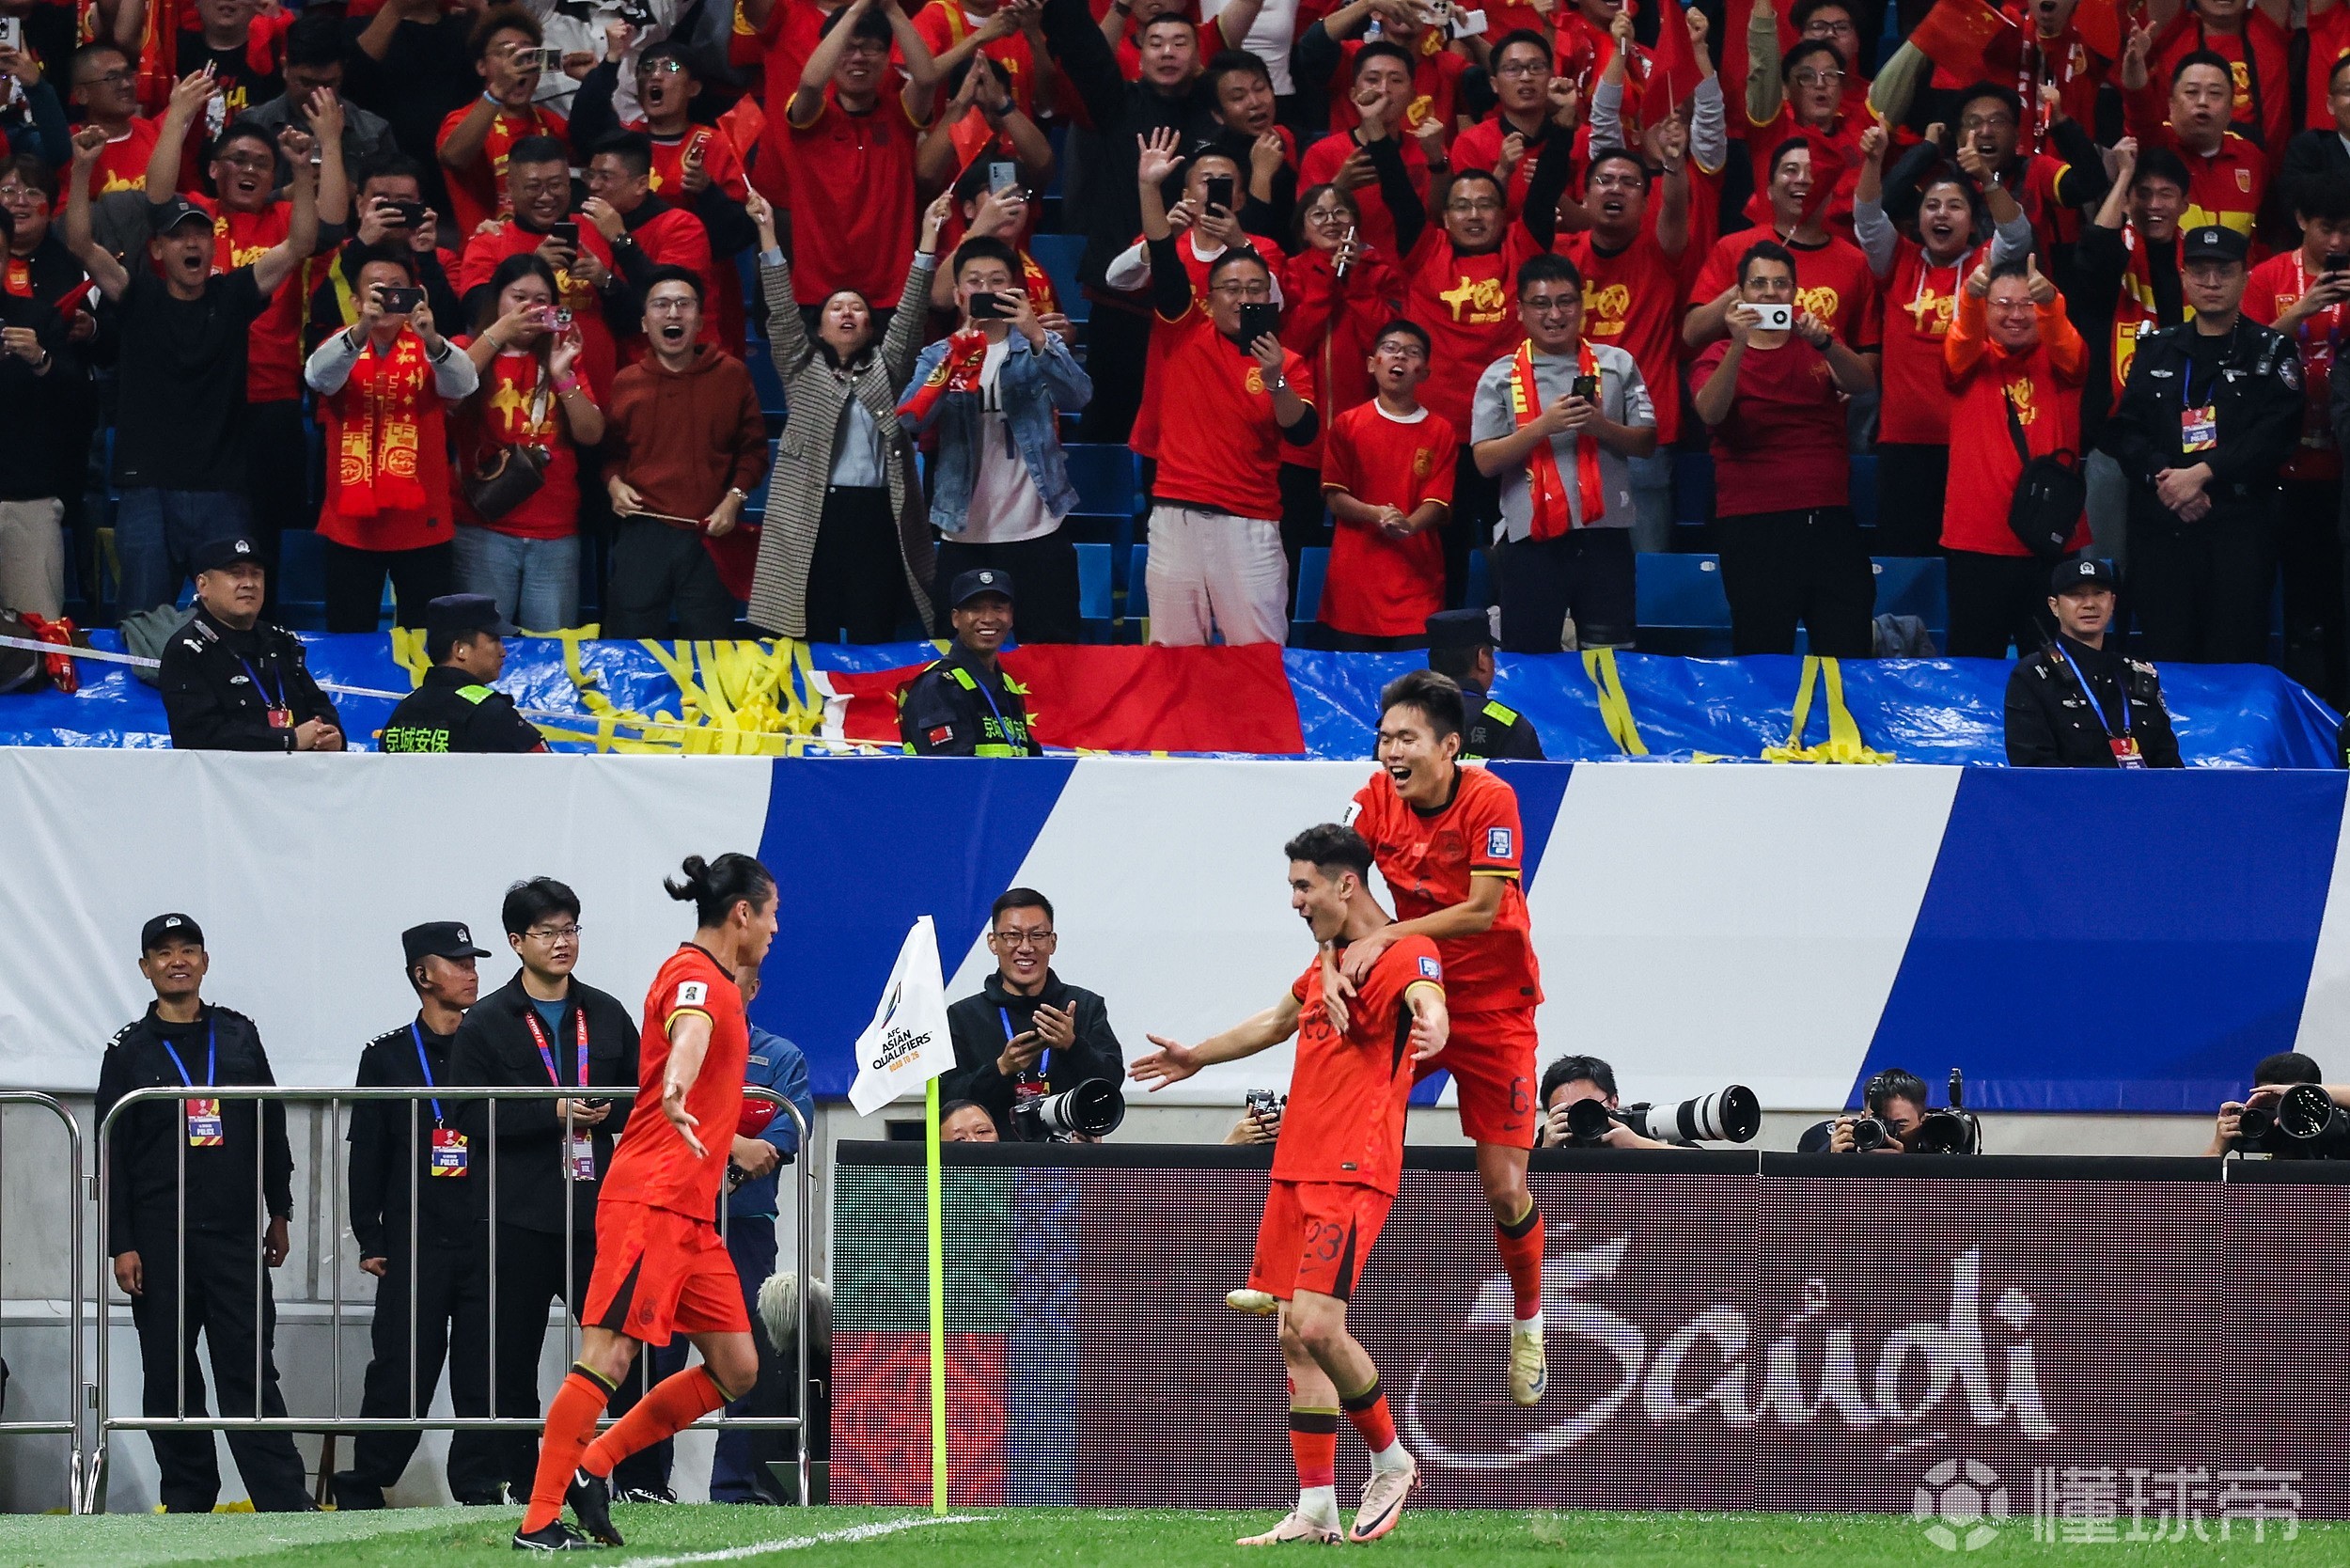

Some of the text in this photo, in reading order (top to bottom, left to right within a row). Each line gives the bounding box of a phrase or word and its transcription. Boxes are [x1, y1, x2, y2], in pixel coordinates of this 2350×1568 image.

[385, 727, 450, 753] 京城安保
[882, 1028, 912, 1055] ASIAN
[887, 1027, 901, 1040] AFC
[888, 1050, 920, 1073] ROAD TO 26
[1509, 1075, 1530, 1117] 6
[196, 1127, 215, 1136] POLICE
[440, 1158, 460, 1167] POLICE
[1407, 1223, 2059, 1469] Saudi
